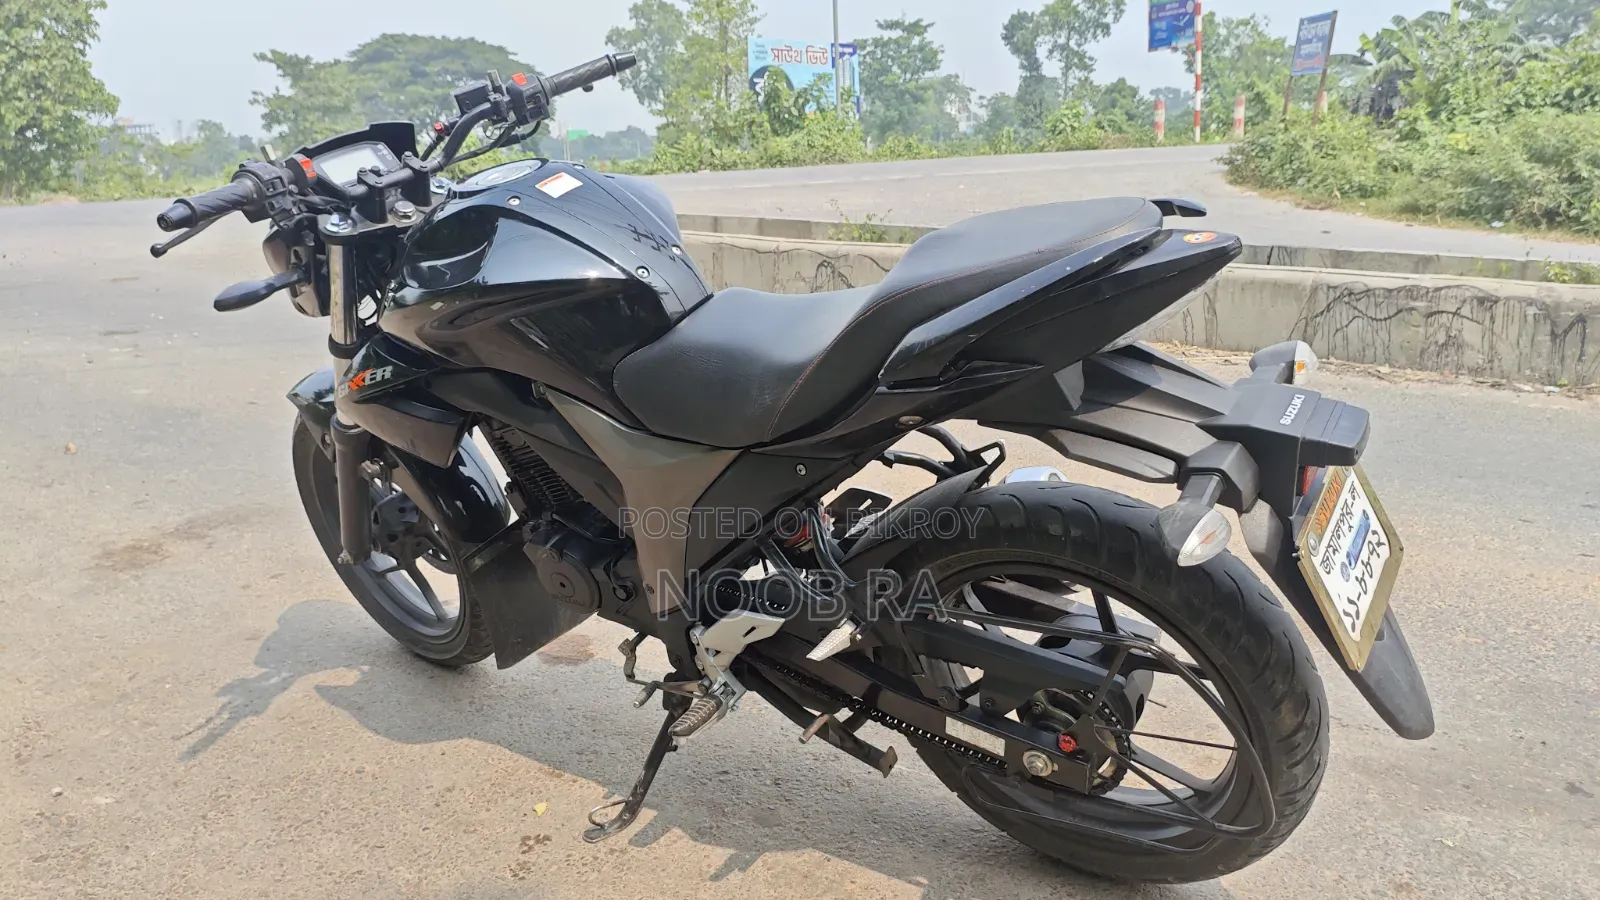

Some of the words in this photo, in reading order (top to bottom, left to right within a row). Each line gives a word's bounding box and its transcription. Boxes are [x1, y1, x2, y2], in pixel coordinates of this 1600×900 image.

[770, 44, 802, 64] সাউথ
[805, 45, 828, 65] ভিউ
[1279, 393, 1306, 426] SUZUKI
